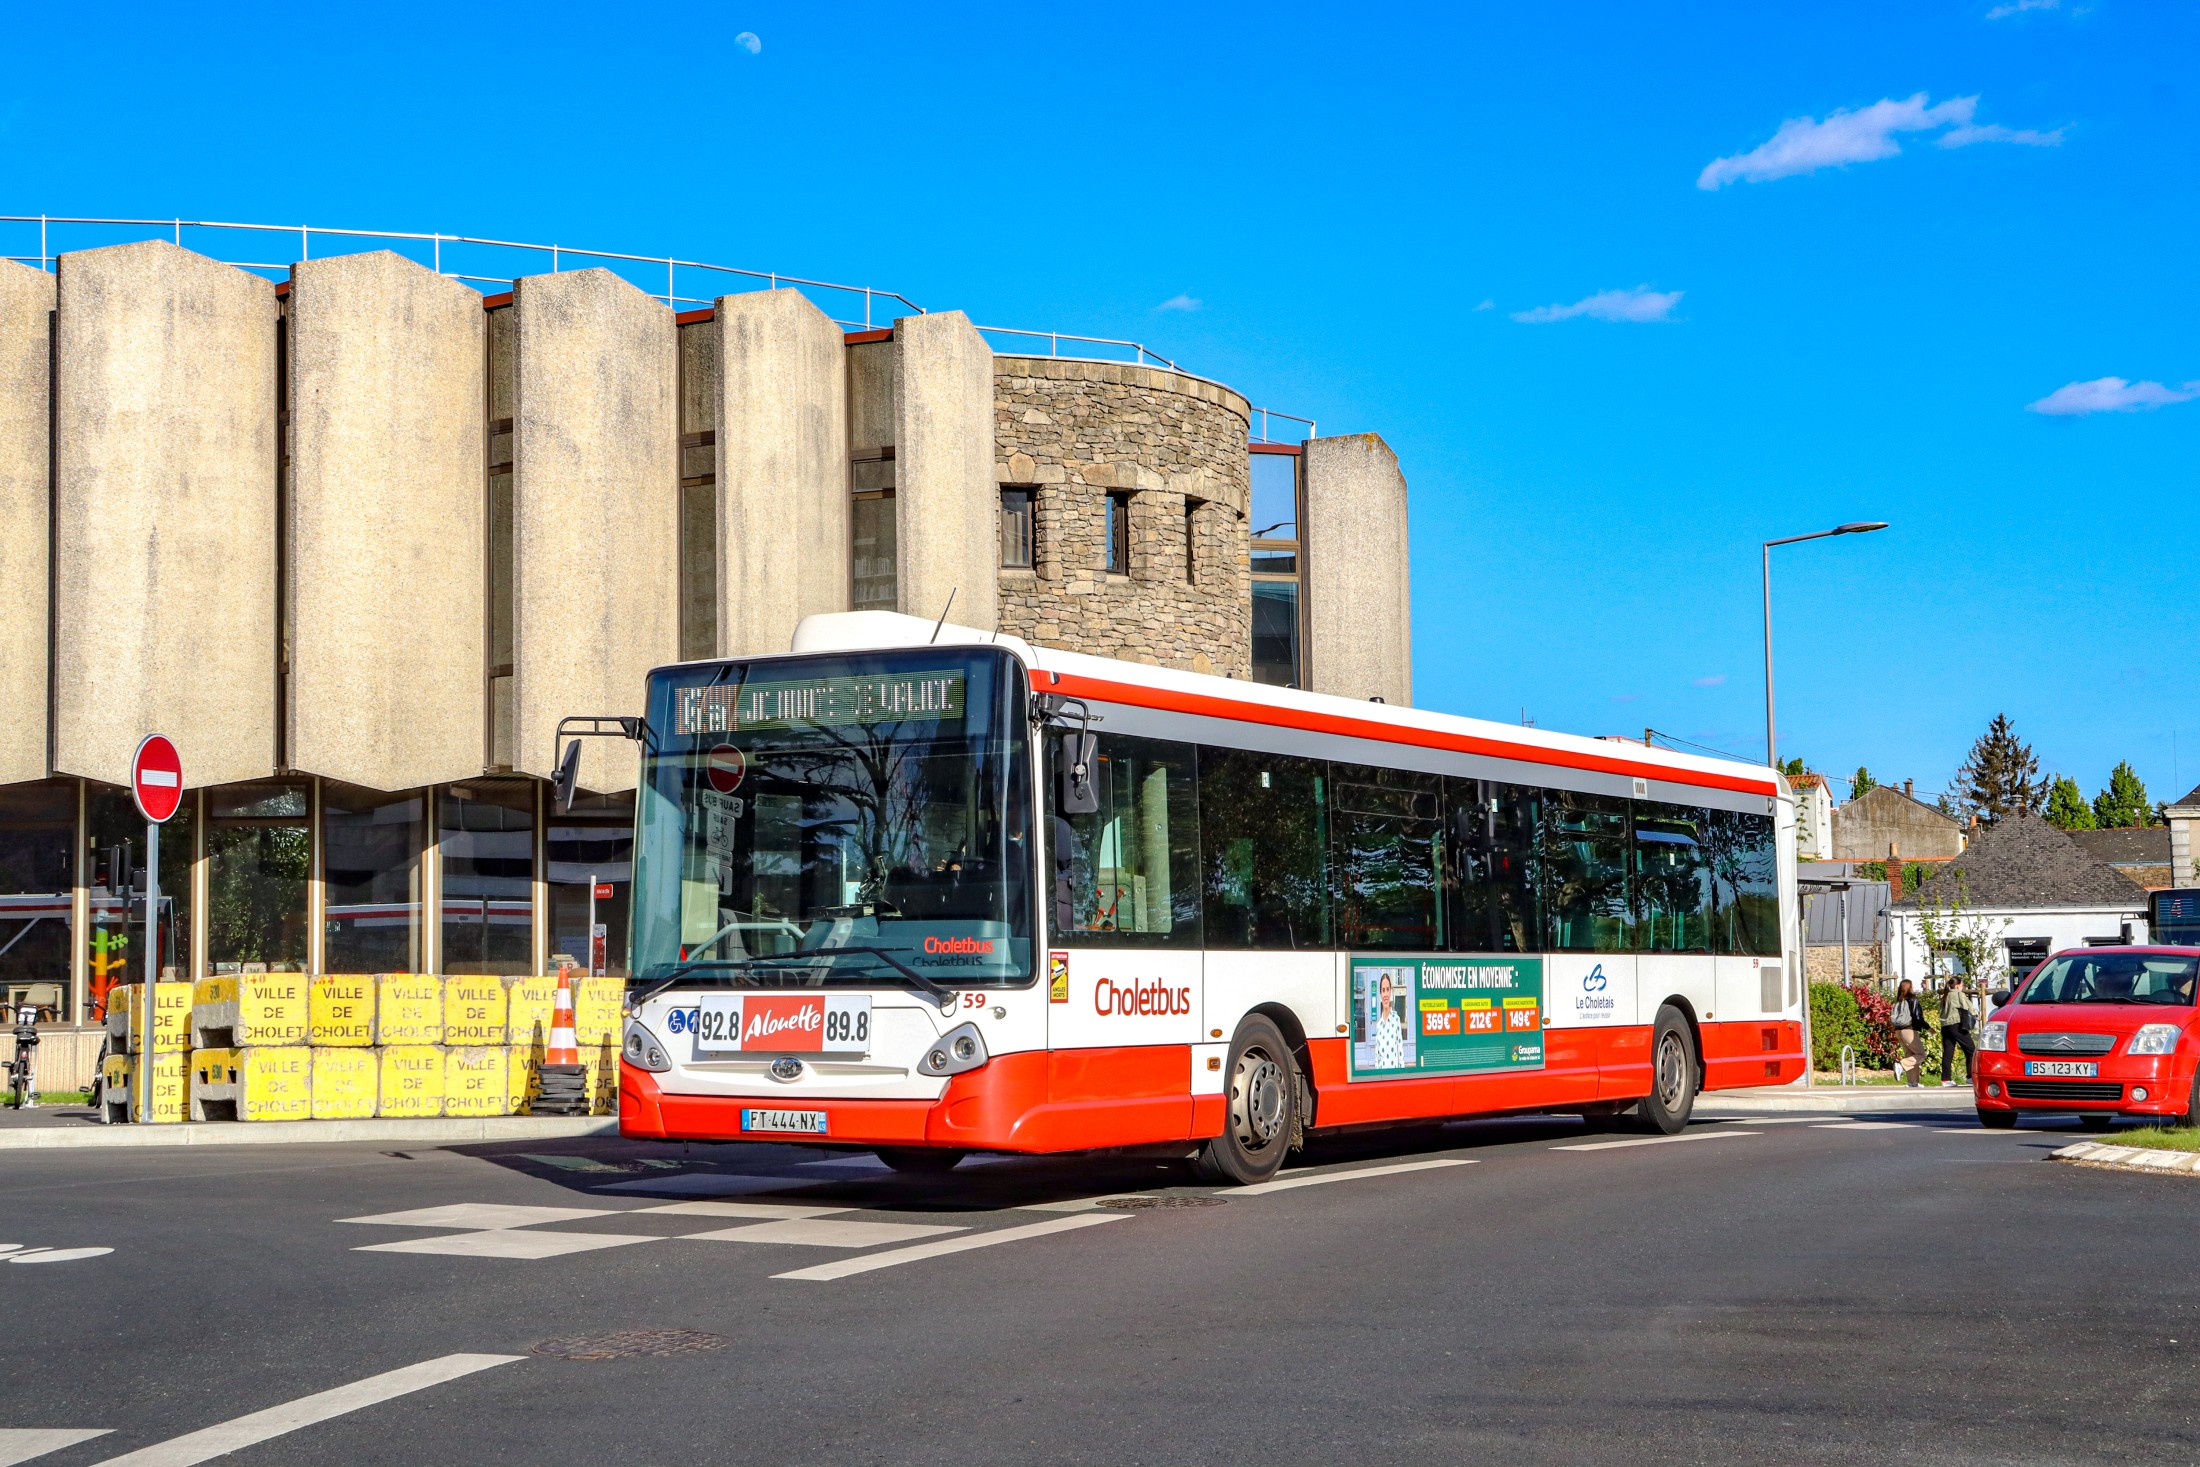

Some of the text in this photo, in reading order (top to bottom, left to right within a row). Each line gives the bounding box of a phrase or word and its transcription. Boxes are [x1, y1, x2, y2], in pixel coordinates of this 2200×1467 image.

[924, 936, 994, 954] Choletbus
[1421, 961, 1466, 989] ÉCONOMISEZ
[1468, 966, 1477, 989] EN
[254, 987, 295, 999] VILLE
[323, 988, 363, 999] VILLE
[393, 988, 432, 999] VILLE
[457, 989, 496, 1001] VILLE
[588, 990, 624, 1002] VILLE
[1095, 977, 1190, 1016] Choletbus
[143, 997, 184, 1008] LLE
[963, 993, 986, 1009] 59
[1576, 996, 1614, 1009] Le Choletais
[264, 1007, 284, 1018] DE
[332, 1007, 352, 1018] DE
[402, 1007, 422, 1018] DE
[466, 1008, 486, 1019] DE
[702, 1011, 740, 1041] 92.8
[744, 1003, 822, 1042] Alouette
[827, 1011, 868, 1041] 89.8
[245, 1027, 304, 1038] CHOLET
[312, 1026, 369, 1037] CHOLET
[382, 1026, 440, 1037] CHOLET
[447, 1027, 503, 1038] CHOLET
[133, 1034, 191, 1047] COLET
[1518, 1045, 1541, 1056] Groupama
[260, 1062, 299, 1073] VILLE
[394, 1058, 433, 1070] VILLE
[458, 1059, 495, 1070] VILLE
[2032, 1063, 2089, 1075] BS-123-KY
[153, 1066, 188, 1077] ILLE
[269, 1081, 288, 1093] DE
[404, 1078, 422, 1089] DE
[466, 1078, 485, 1089] DE
[594, 1078, 611, 1089] DE
[156, 1085, 176, 1096] DE
[247, 1100, 307, 1113] CHOLET
[383, 1097, 441, 1109] CHOLET
[446, 1097, 501, 1108] CHOLET
[135, 1102, 190, 1115] COLE
